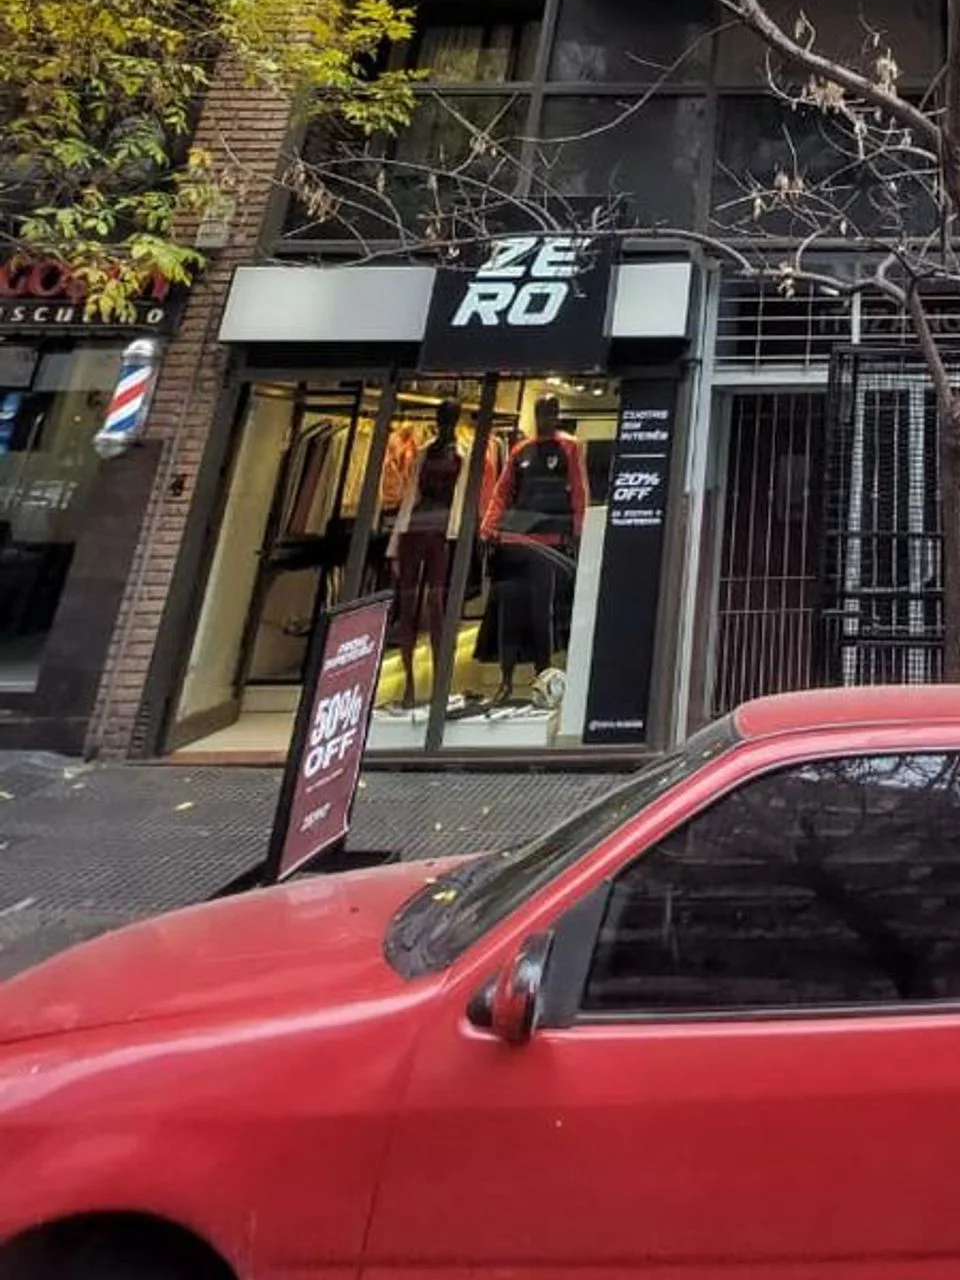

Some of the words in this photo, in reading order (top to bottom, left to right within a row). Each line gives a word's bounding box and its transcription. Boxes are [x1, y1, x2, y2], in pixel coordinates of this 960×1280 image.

[477, 236, 584, 278] ZE
[451, 282, 569, 326] RO
[613, 487, 654, 501] OFF
[614, 472, 661, 486] 20%
[310, 683, 363, 746] 50%
[304, 728, 356, 778] OFF
